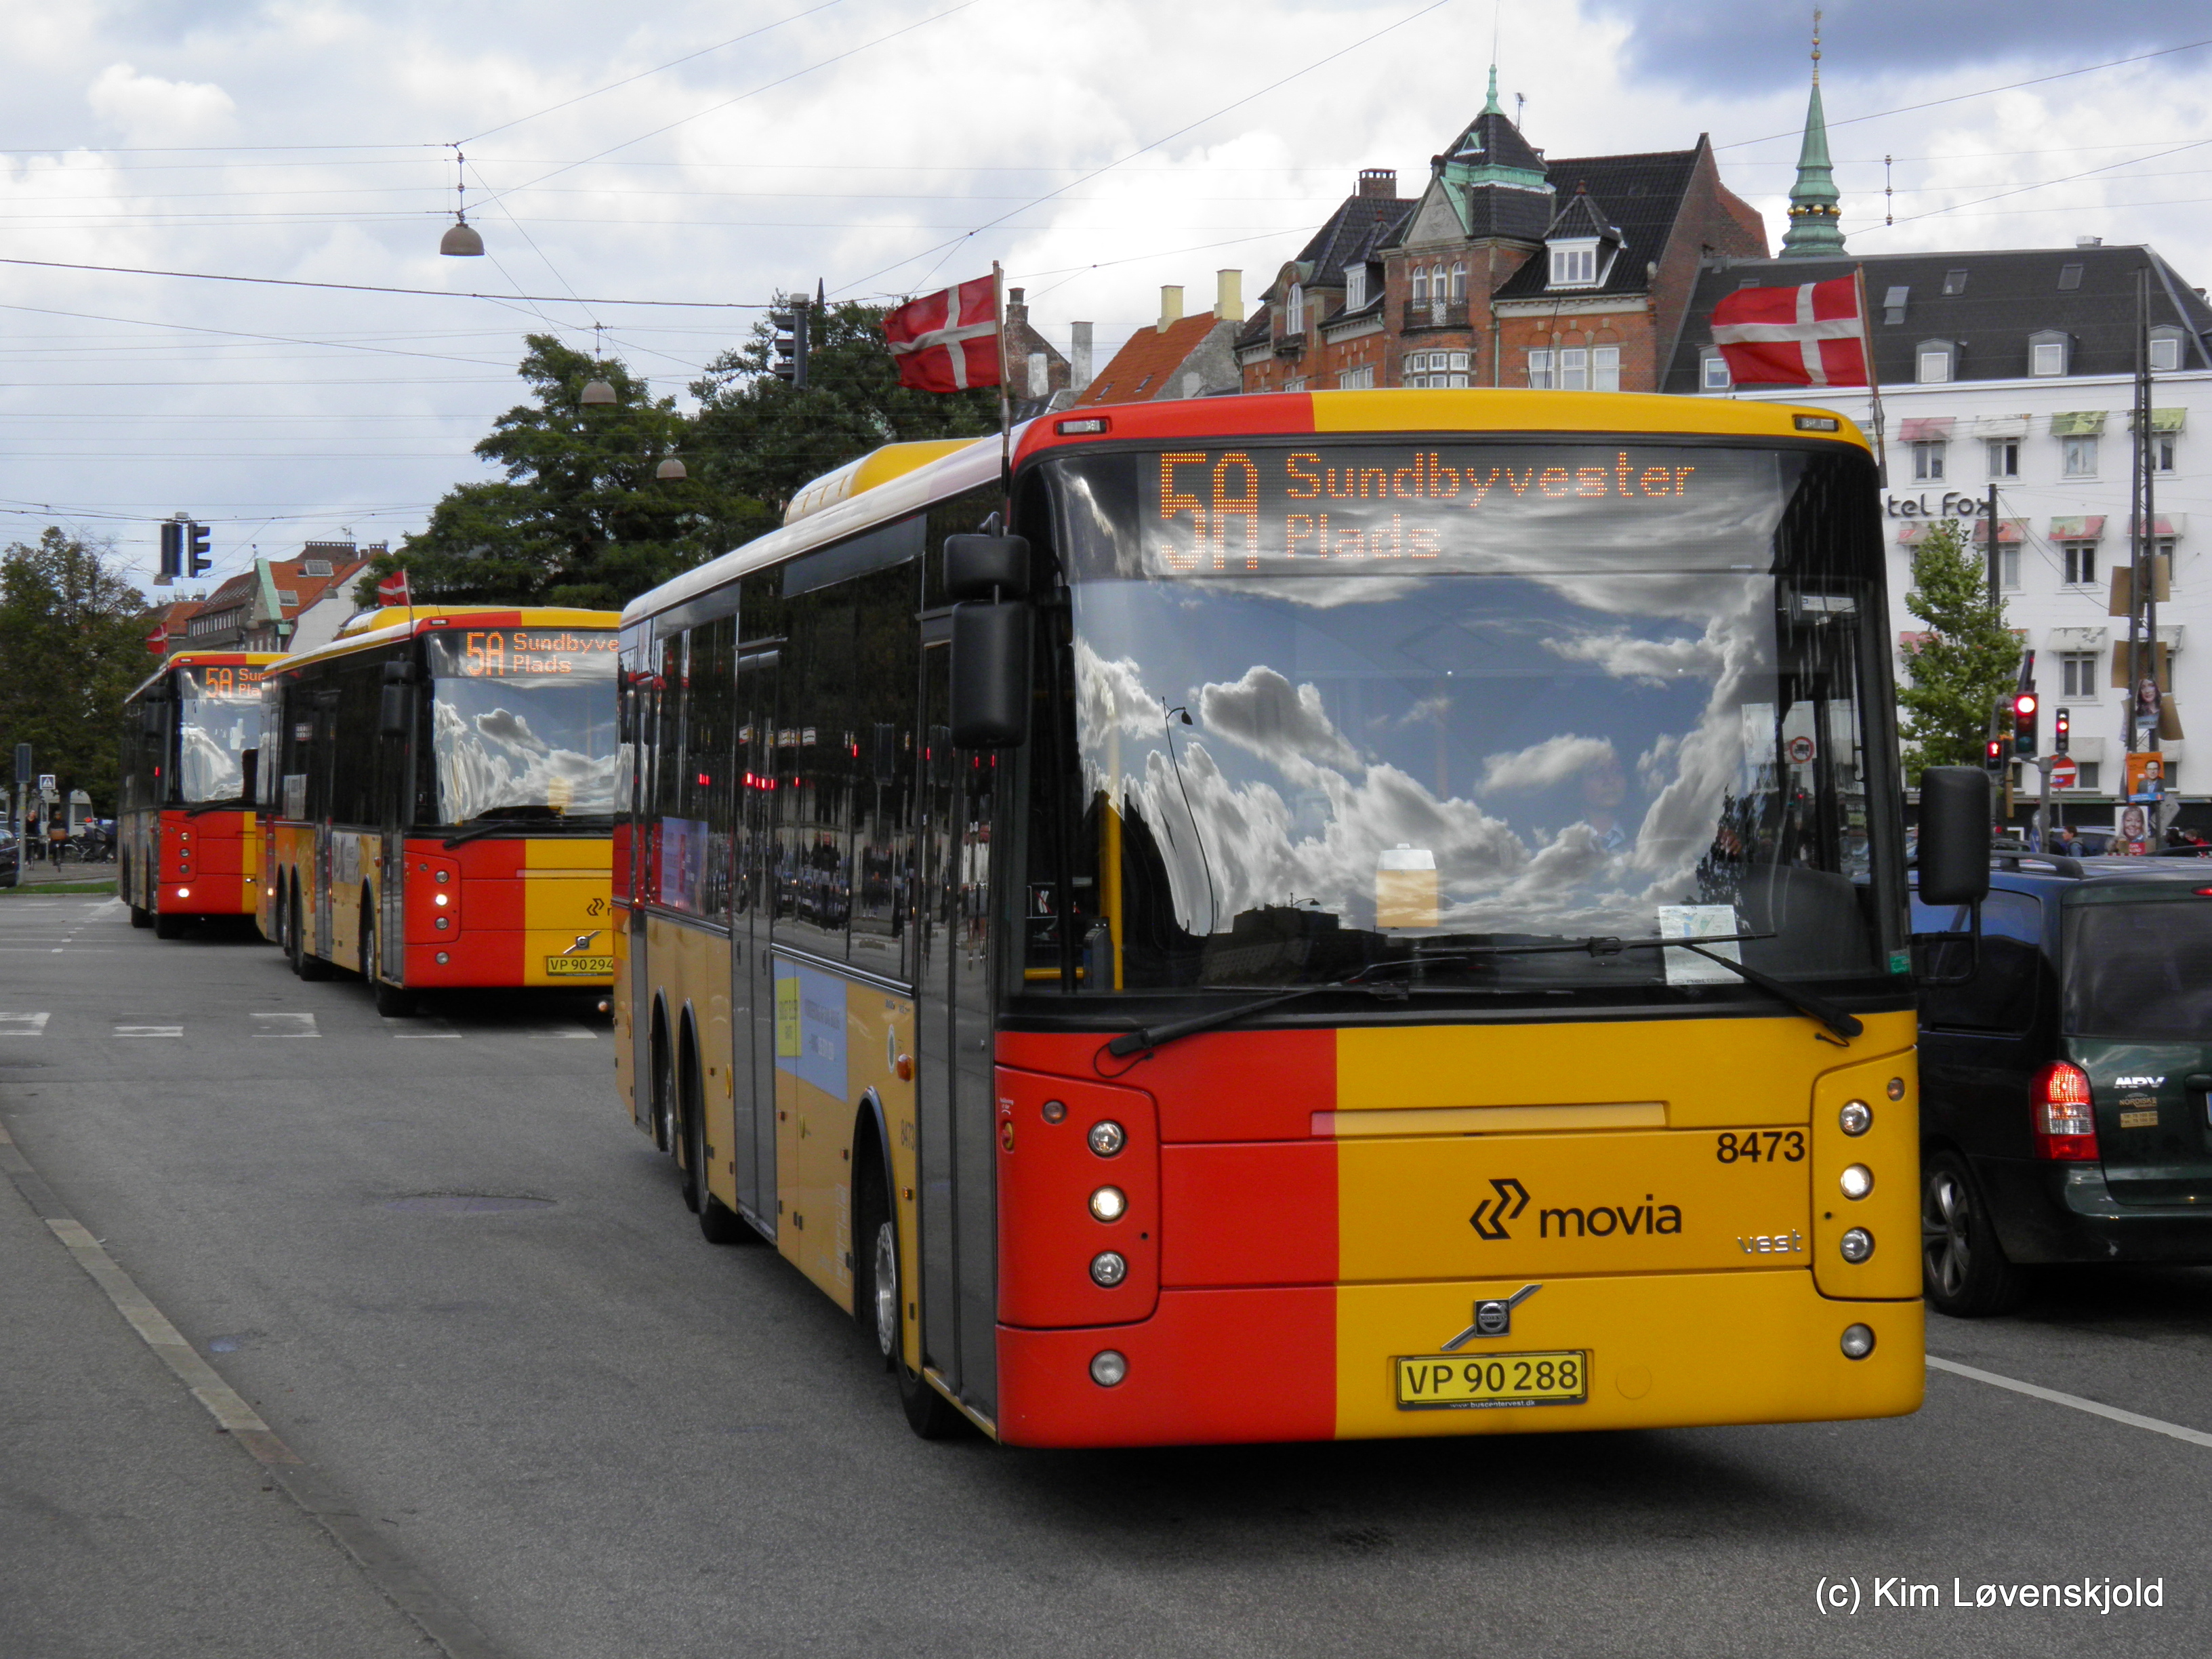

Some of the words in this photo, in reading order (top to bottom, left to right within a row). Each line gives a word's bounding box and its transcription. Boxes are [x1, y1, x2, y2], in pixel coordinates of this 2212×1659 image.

[1160, 452, 1258, 569] 5A
[1286, 452, 1695, 507] Sundbyvester
[1881, 493, 1933, 518] tel
[1286, 513, 1441, 558] Plads
[466, 632, 505, 676] 5A
[513, 655, 572, 674] Plads
[205, 668, 233, 698] 5A
[550, 959, 568, 970] VP
[571, 959, 588, 970] 90
[590, 959, 613, 970] 294
[2114, 1076, 2165, 1089] MPV
[1716, 1130, 1806, 1164] 8473
[1540, 1193, 1683, 1239] movia
[1737, 1228, 1803, 1254] vest
[1406, 1365, 1454, 1395] VP
[1463, 1362, 1505, 1393] 90
[1513, 1360, 1578, 1391] 288
